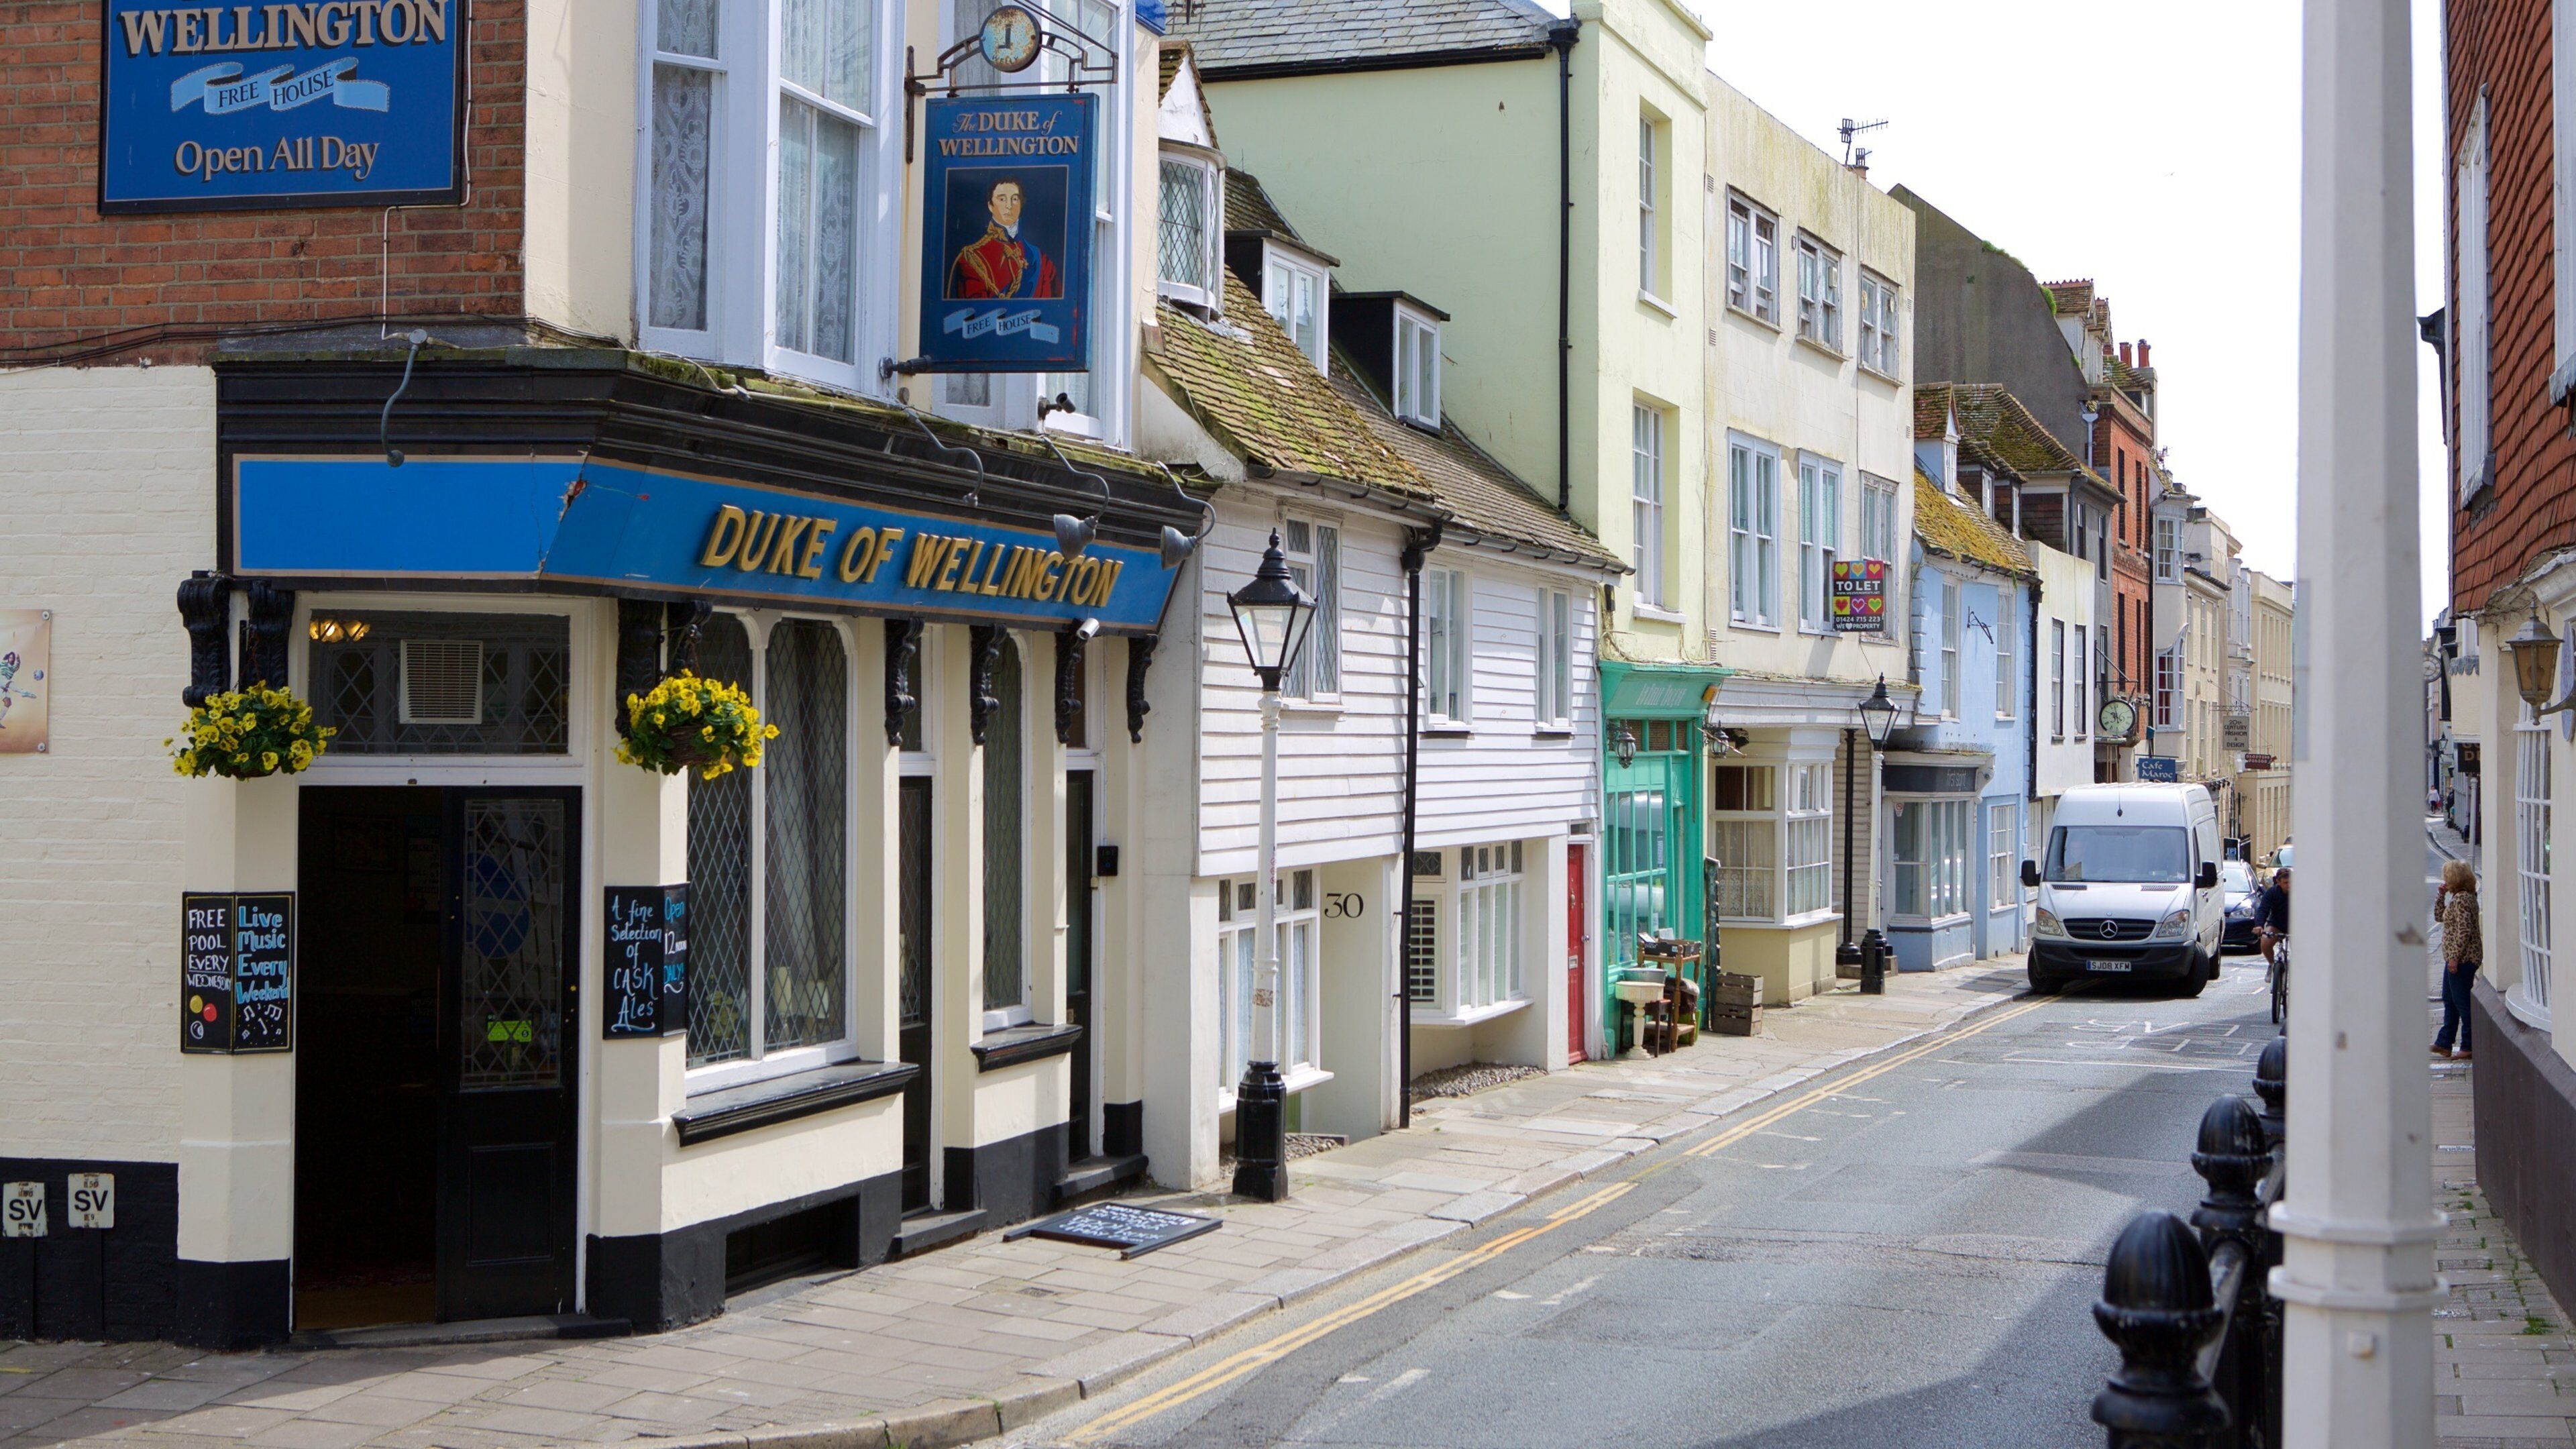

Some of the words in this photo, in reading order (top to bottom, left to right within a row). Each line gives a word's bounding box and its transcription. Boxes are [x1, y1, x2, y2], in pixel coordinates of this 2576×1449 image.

[119, 0, 448, 55] WELLINGTON
[218, 81, 259, 108] FREE
[272, 69, 333, 105] HOUSE
[953, 113, 975, 133] The
[978, 111, 1040, 131] DUKE
[1041, 111, 1063, 135] of
[939, 136, 1079, 156] WELLINGTON
[175, 140, 263, 181] Open
[270, 136, 313, 172] All
[321, 136, 380, 180] Day
[967, 317, 991, 334] FREE
[999, 315, 1031, 331] HOUSE
[700, 504, 838, 580] DUKE
[839, 527, 906, 584] OF
[906, 533, 1124, 607] WELLINGTON
[1836, 581, 1853, 591] TO
[1856, 581, 1880, 591] LET
[2141, 761, 2163, 769] Cafe
[2141, 769, 2173, 778] Maroc
[238, 906, 283, 927] Live
[612, 895, 623, 921] A
[628, 900, 654, 926] fine
[665, 896, 685, 923] Open
[1324, 893, 1364, 918] 30
[189, 908, 226, 930] FREE
[189, 934, 227, 951] POOL
[237, 928, 286, 952] Music
[611, 922, 662, 943] Selection
[665, 930, 675, 955] 12
[189, 955, 229, 971] EVERY
[626, 942, 640, 969] of
[237, 953, 288, 986] Every
[186, 973, 231, 991] WEDNESDAY
[235, 976, 290, 1005] Weekend
[618, 996, 654, 1032] Ales
[9, 1199, 42, 1220] SV
[74, 1190, 108, 1212] SV
